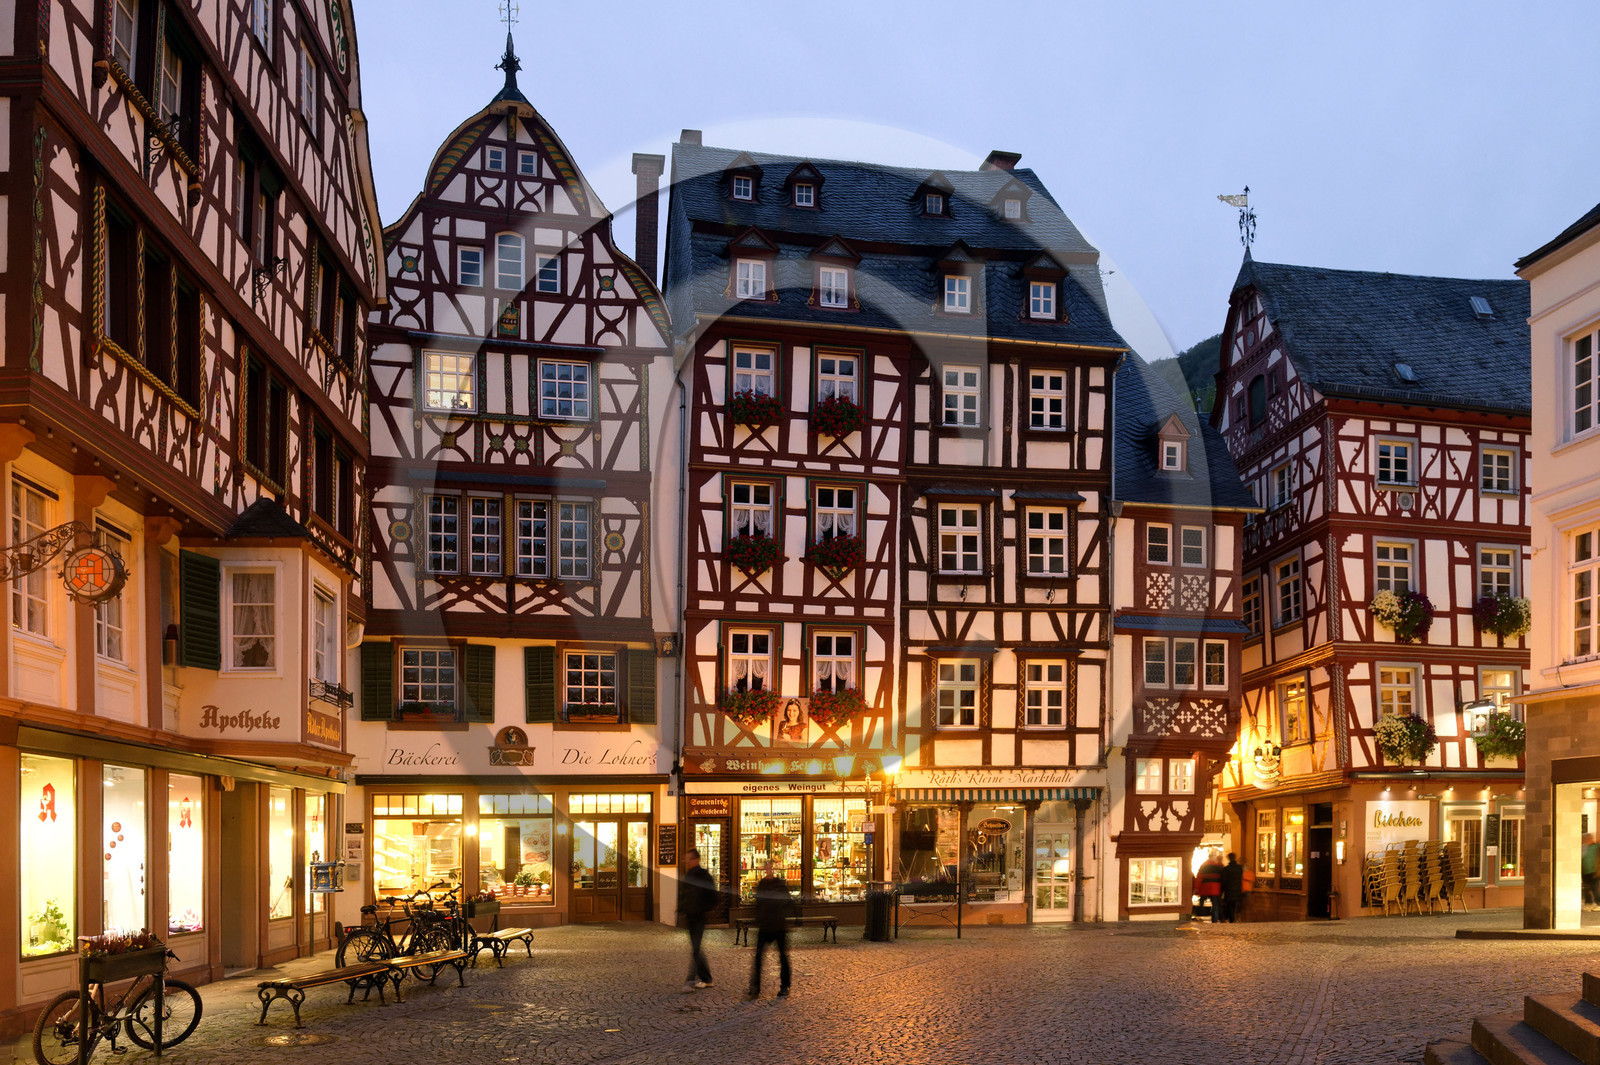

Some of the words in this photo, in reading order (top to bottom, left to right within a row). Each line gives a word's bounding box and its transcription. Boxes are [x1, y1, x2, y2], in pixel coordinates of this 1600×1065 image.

[199, 705, 281, 733] Apotheke
[306, 711, 321, 736] Adler
[387, 743, 461, 766] Bäckerei
[561, 748, 593, 766] Die
[597, 740, 657, 766] Lohner's
[726, 759, 785, 772] Weinha
[742, 783, 780, 793] eigenes
[788, 783, 826, 793] Weingut
[928, 772, 962, 787] Rath's
[967, 772, 1005, 785] Kleine
[1008, 772, 1075, 784] Markthalle
[690, 798, 724, 806] Souvenirs
